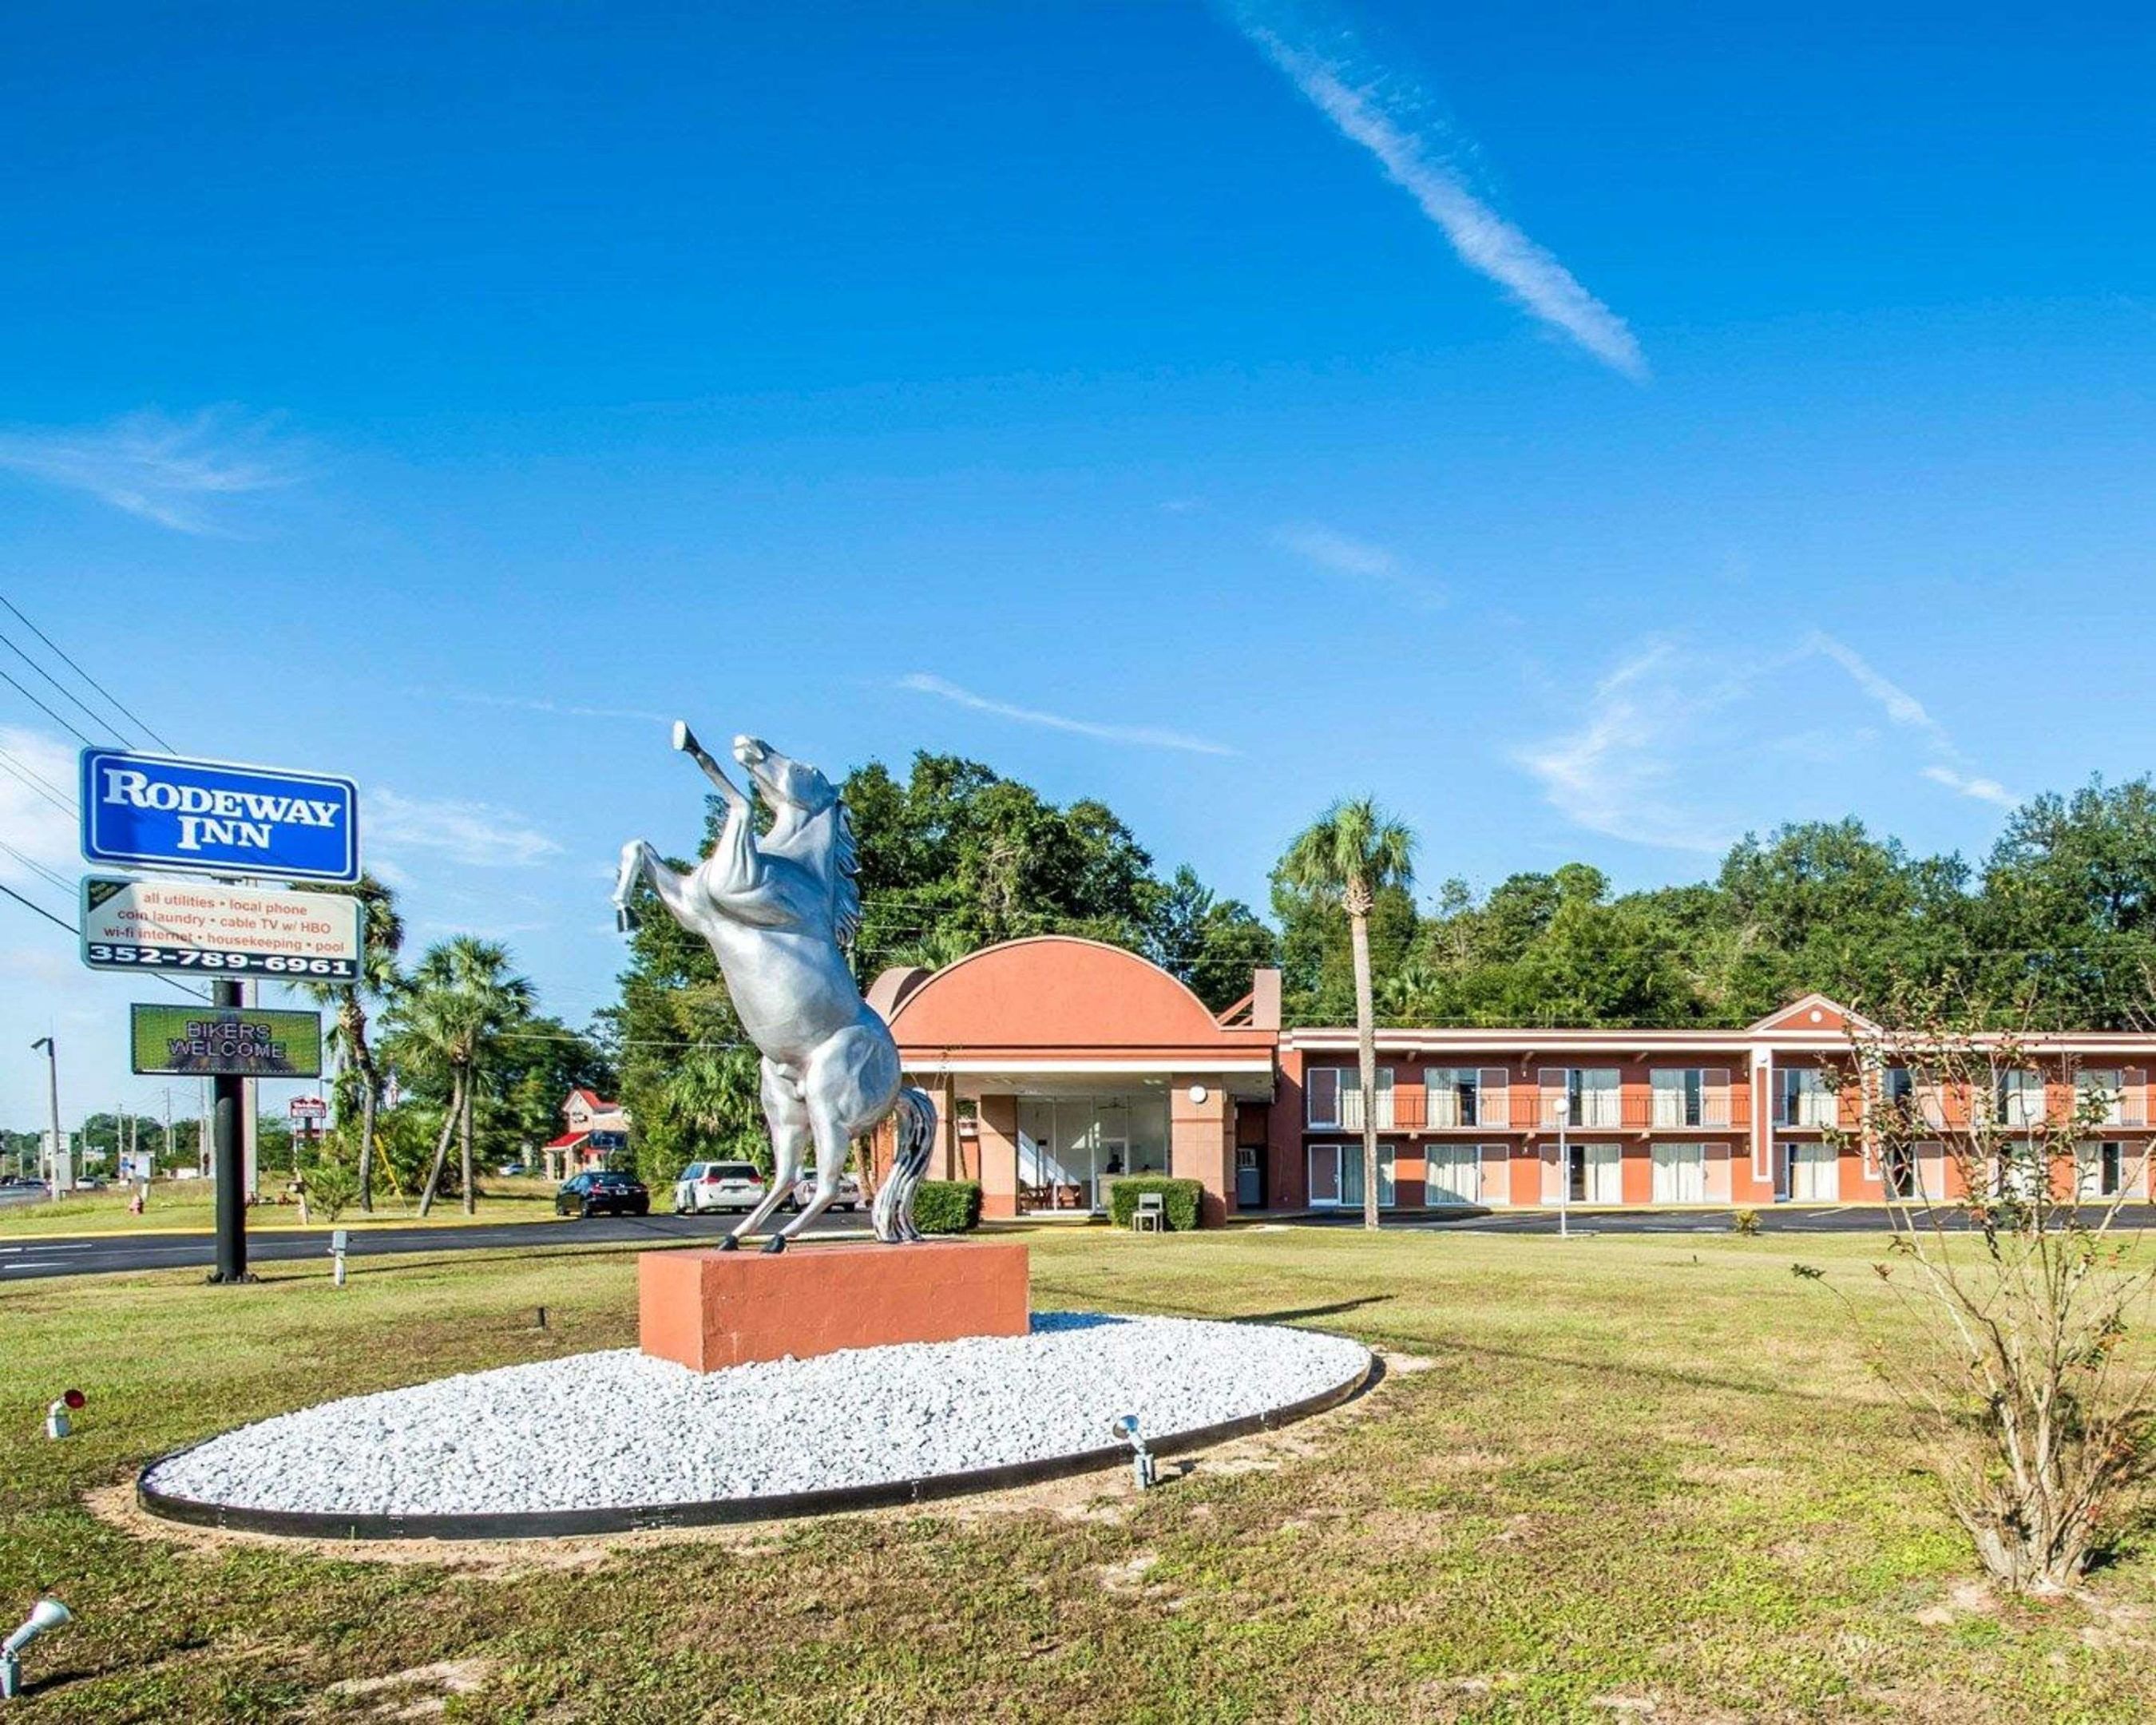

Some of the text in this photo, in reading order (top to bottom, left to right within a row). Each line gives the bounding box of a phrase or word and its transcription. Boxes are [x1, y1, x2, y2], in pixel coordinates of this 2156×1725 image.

[102, 767, 341, 827] RODEWAY
[177, 815, 272, 851] INN
[143, 890, 307, 916] all utilities local phone
[117, 909, 331, 934] coin laundry cable TV w/ HBO
[104, 926, 345, 953] wi-fi internet housekeeping pool
[89, 944, 352, 976] 352-789-6961
[186, 1021, 271, 1038] BIKERS
[168, 1039, 286, 1059] WELCOME
